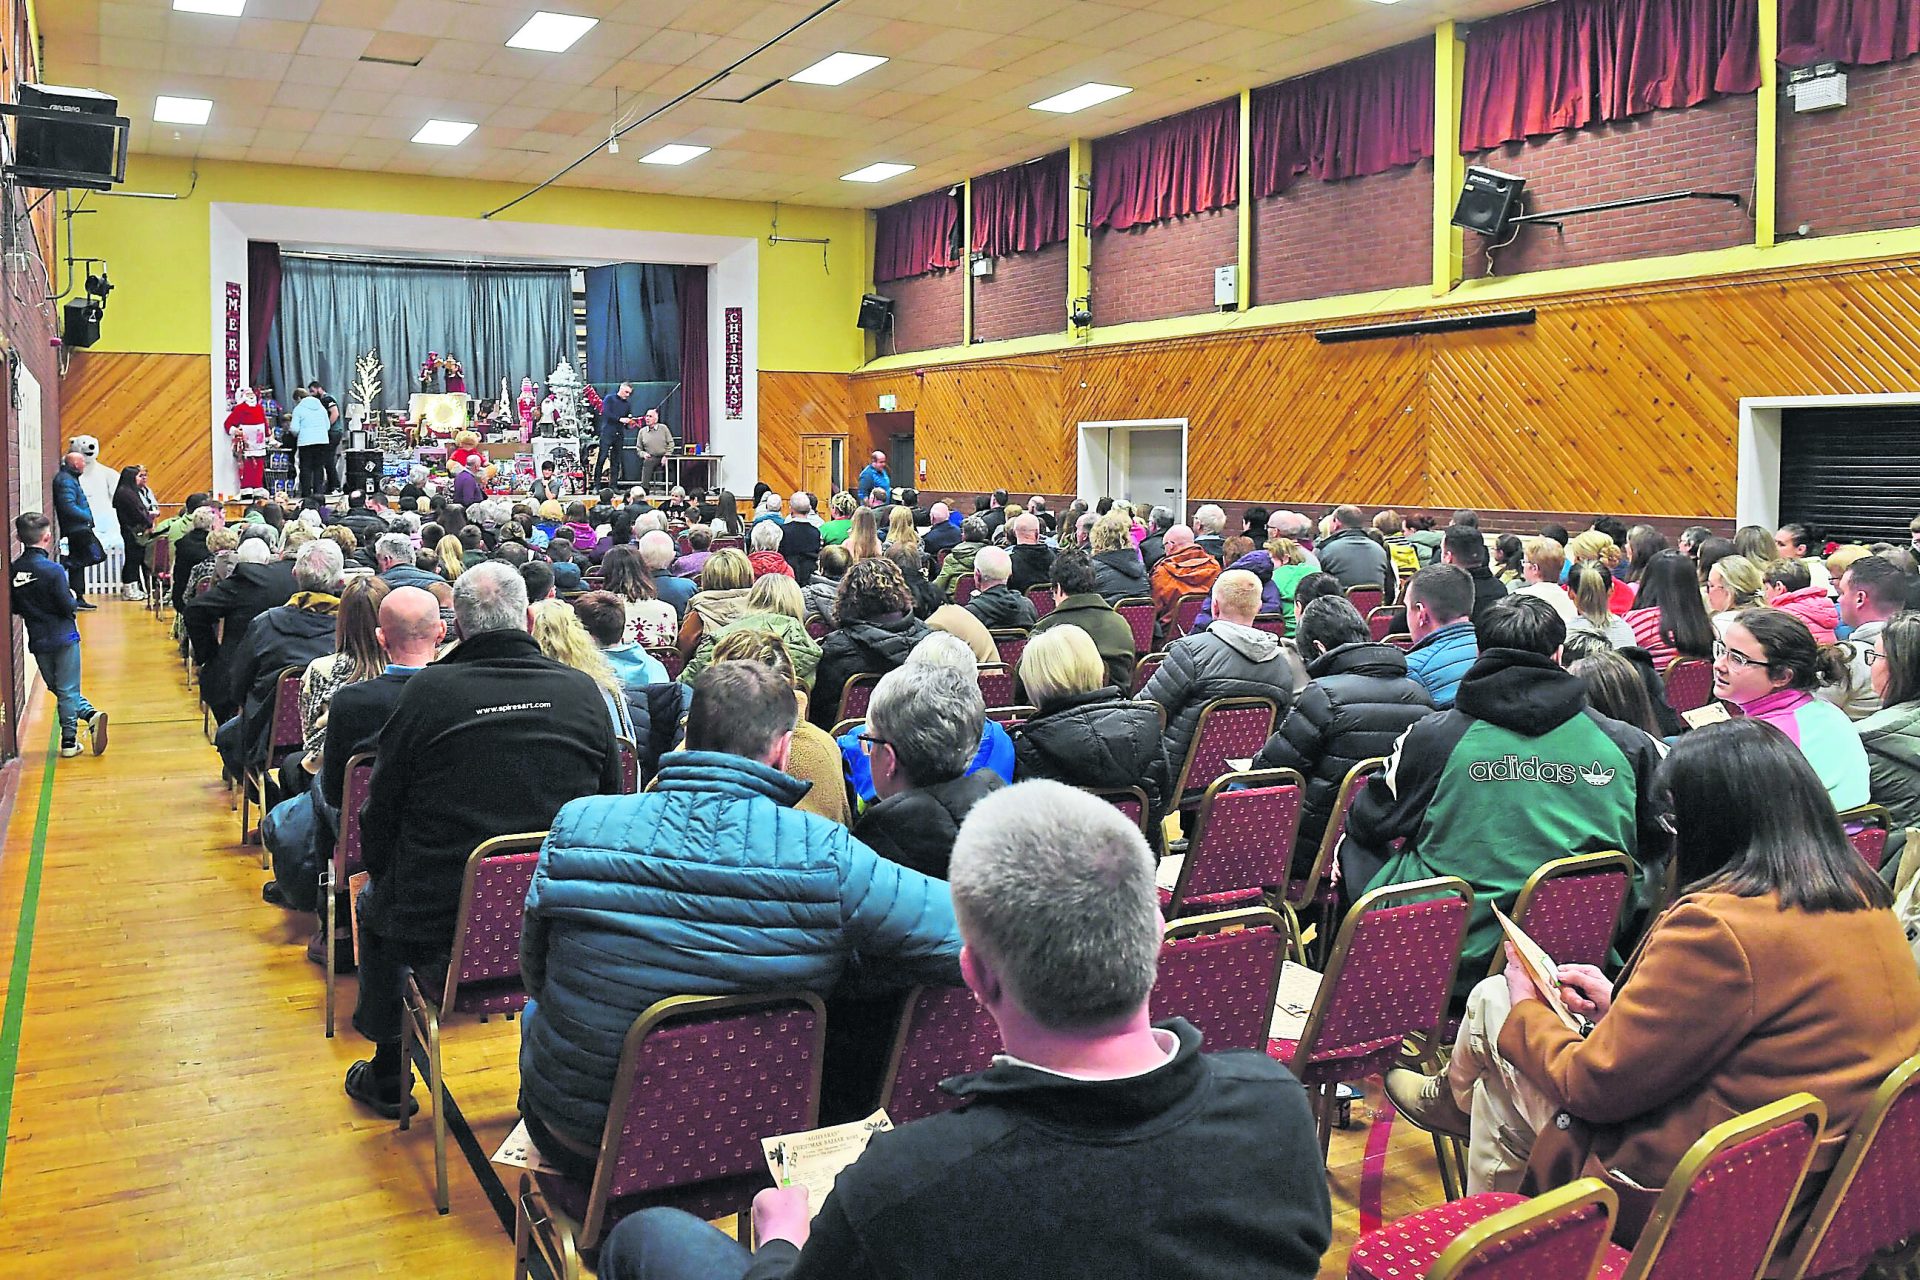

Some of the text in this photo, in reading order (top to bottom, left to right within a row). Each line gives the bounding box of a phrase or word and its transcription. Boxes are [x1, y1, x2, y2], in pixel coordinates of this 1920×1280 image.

[228, 298, 239, 391] MERRY
[729, 313, 740, 404] CHRISTMAS
[475, 702, 551, 715] www.spiresart.com
[1469, 755, 1577, 784] adidas
